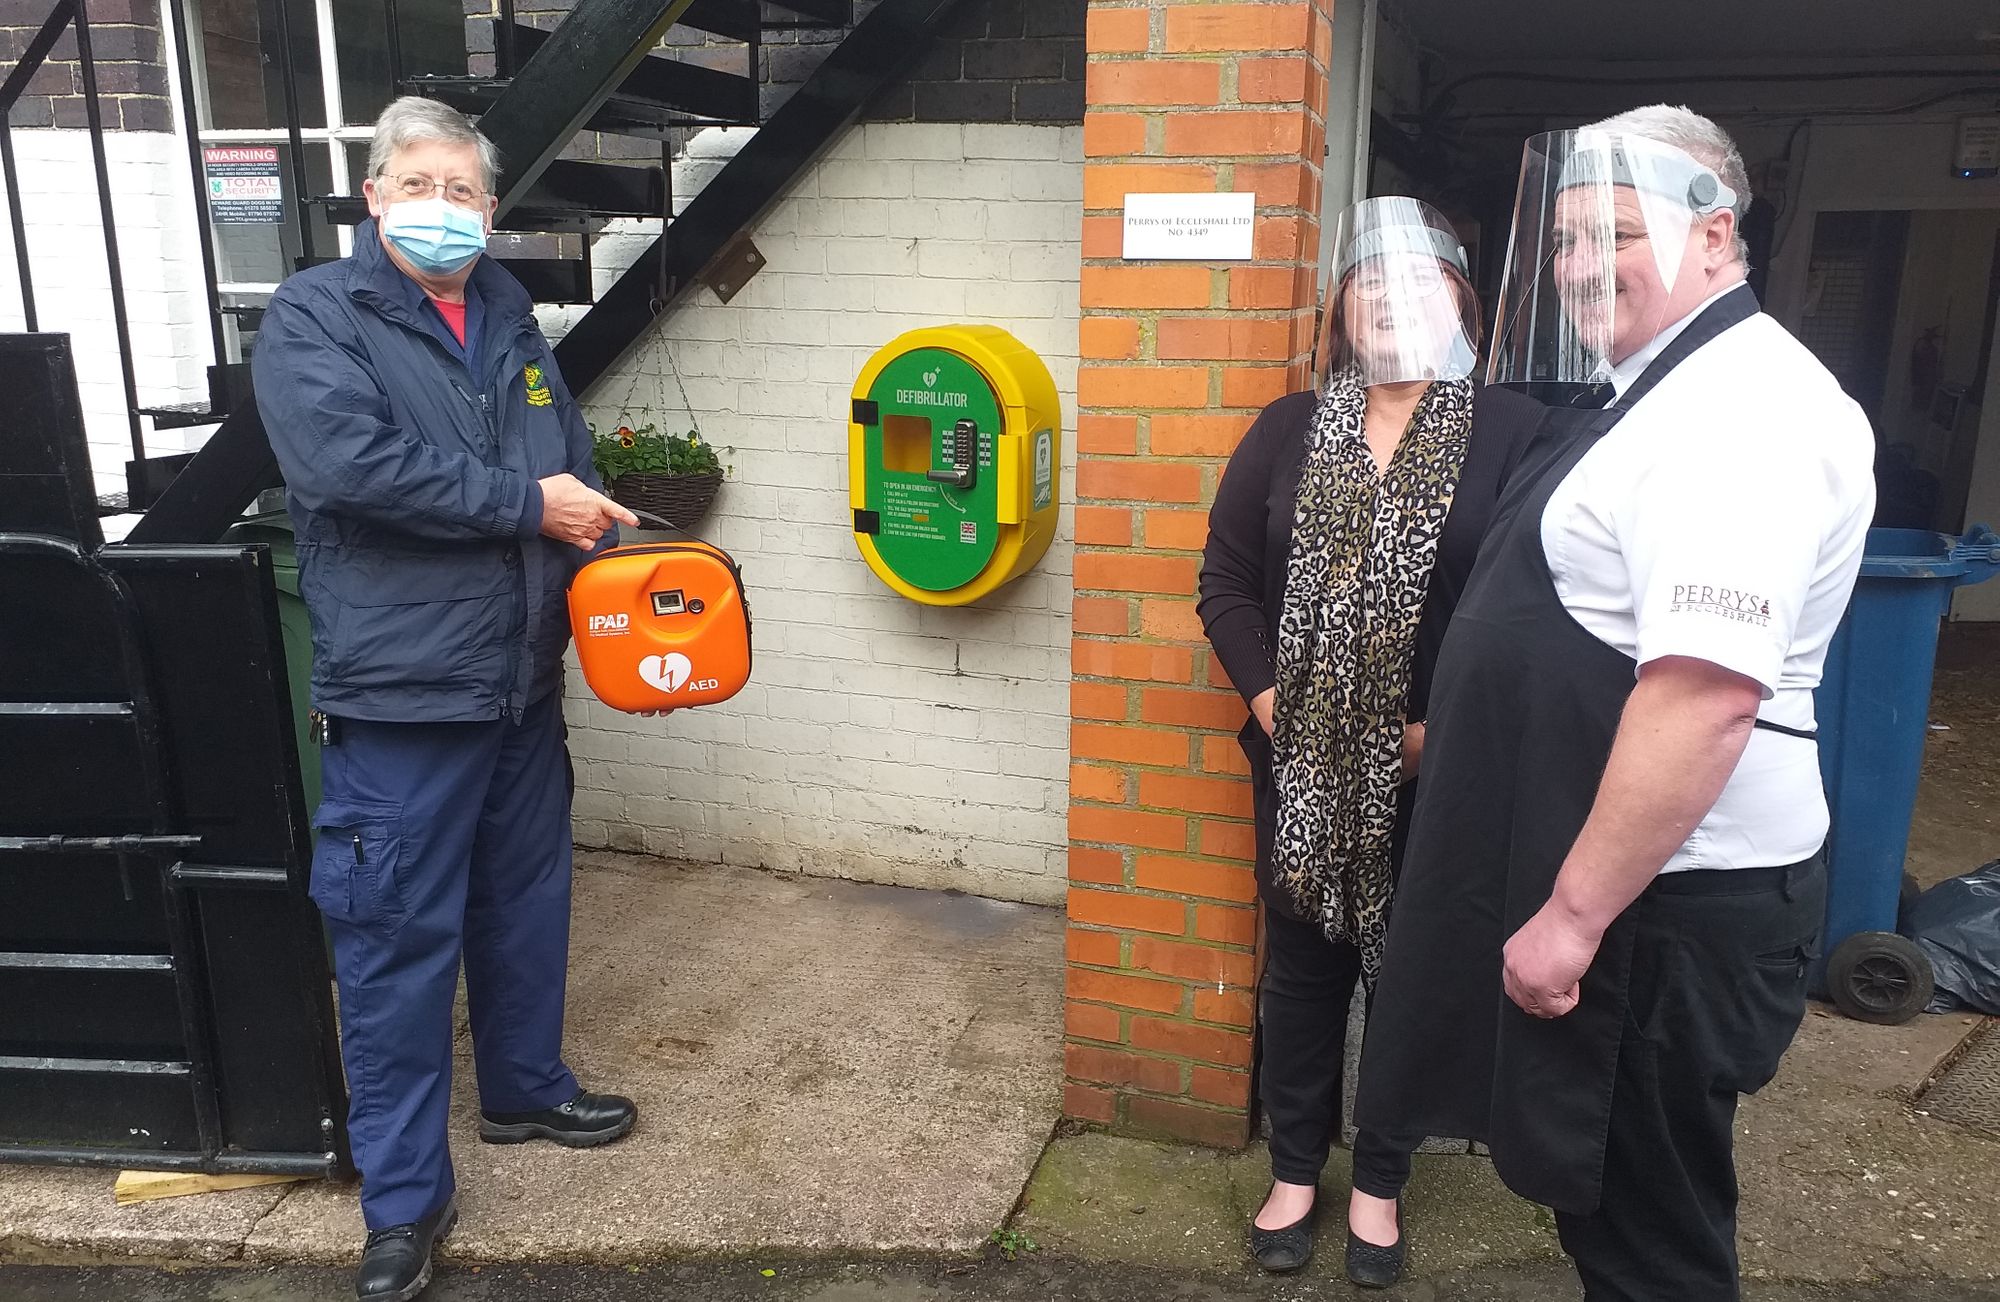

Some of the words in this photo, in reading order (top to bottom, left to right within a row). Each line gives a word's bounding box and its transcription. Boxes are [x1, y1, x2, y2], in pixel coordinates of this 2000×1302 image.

[206, 150, 275, 161] WARNING
[223, 178, 278, 187] TOTAL
[896, 388, 968, 408] DEFIBRILLATOR
[911, 484, 938, 492] EMERGENCY
[1672, 585, 1760, 613] PERRYS
[589, 613, 629, 630] IPAD
[1686, 604, 1768, 627] ECCLESHALL
[688, 678, 719, 692] AED
